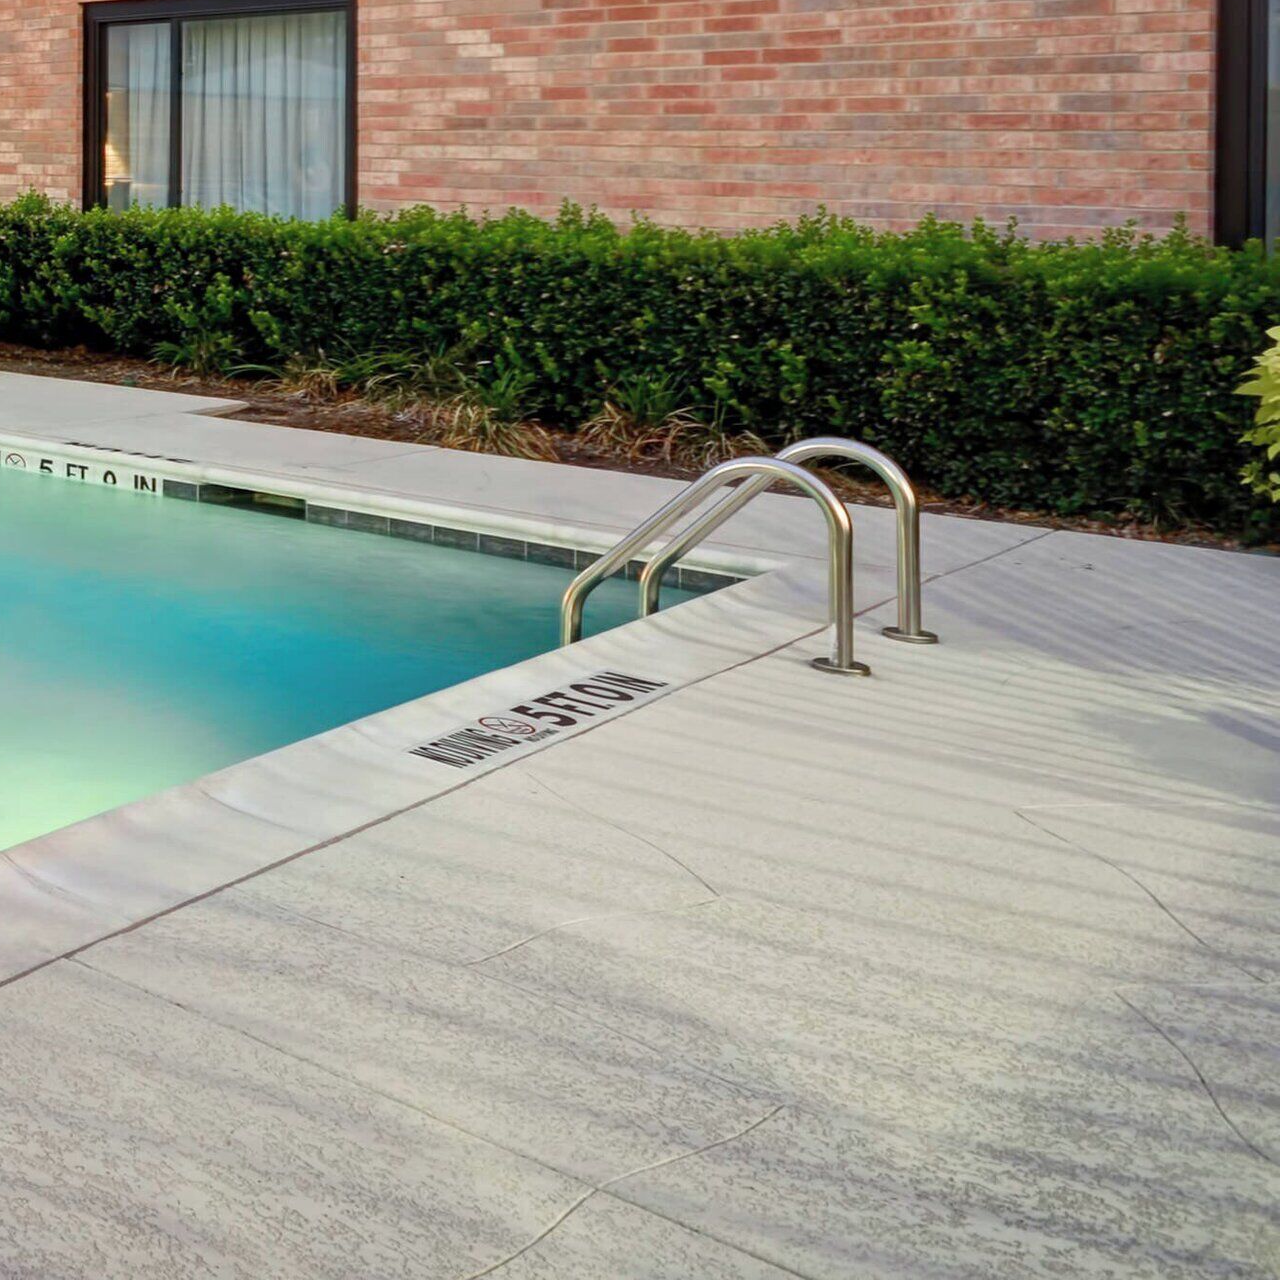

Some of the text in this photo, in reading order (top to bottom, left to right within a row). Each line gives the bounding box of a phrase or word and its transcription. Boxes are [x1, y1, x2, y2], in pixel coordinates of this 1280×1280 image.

[40, 458, 54, 473] 5
[66, 463, 89, 481] FT
[133, 474, 157, 492] IN
[509, 705, 577, 727] 5
